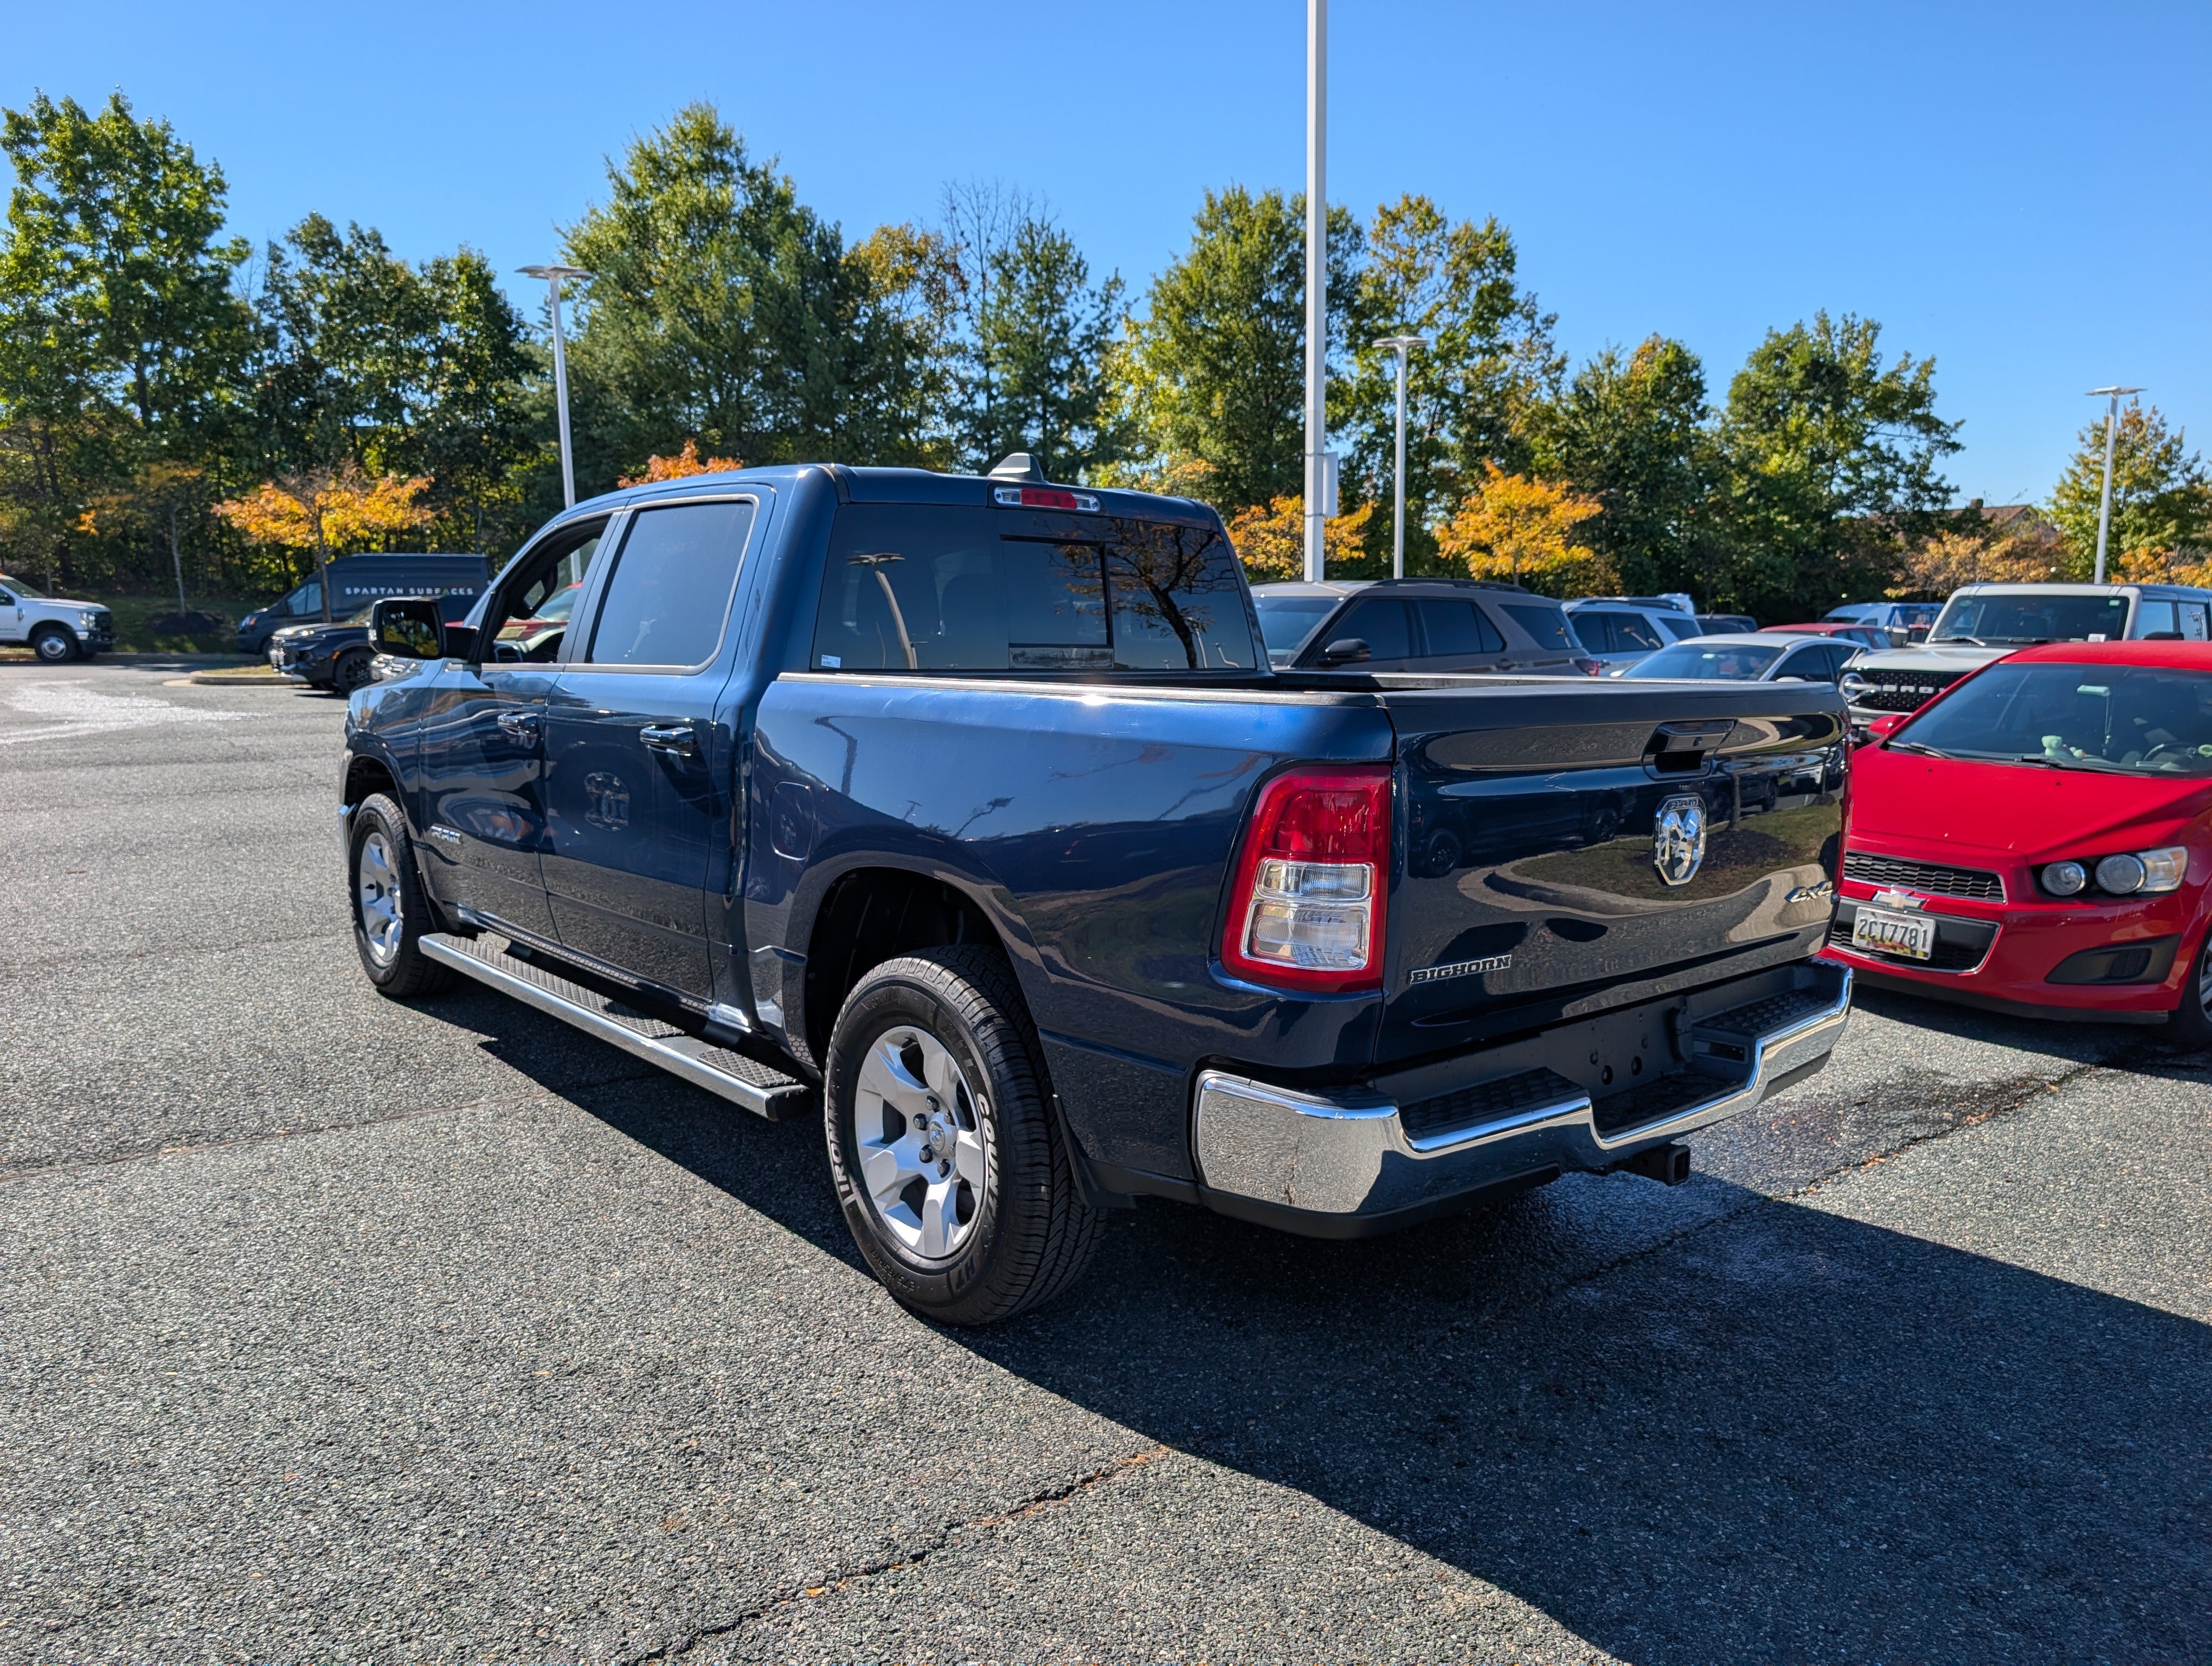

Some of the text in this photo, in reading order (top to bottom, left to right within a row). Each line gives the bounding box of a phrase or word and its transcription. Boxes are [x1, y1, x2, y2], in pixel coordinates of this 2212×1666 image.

[345, 587, 474, 595] SPARTAN SURFACES
[1669, 798, 1699, 809] RAM
[1859, 917, 1928, 949] 2CT7781
[1410, 954, 1512, 985] BIGHORN
